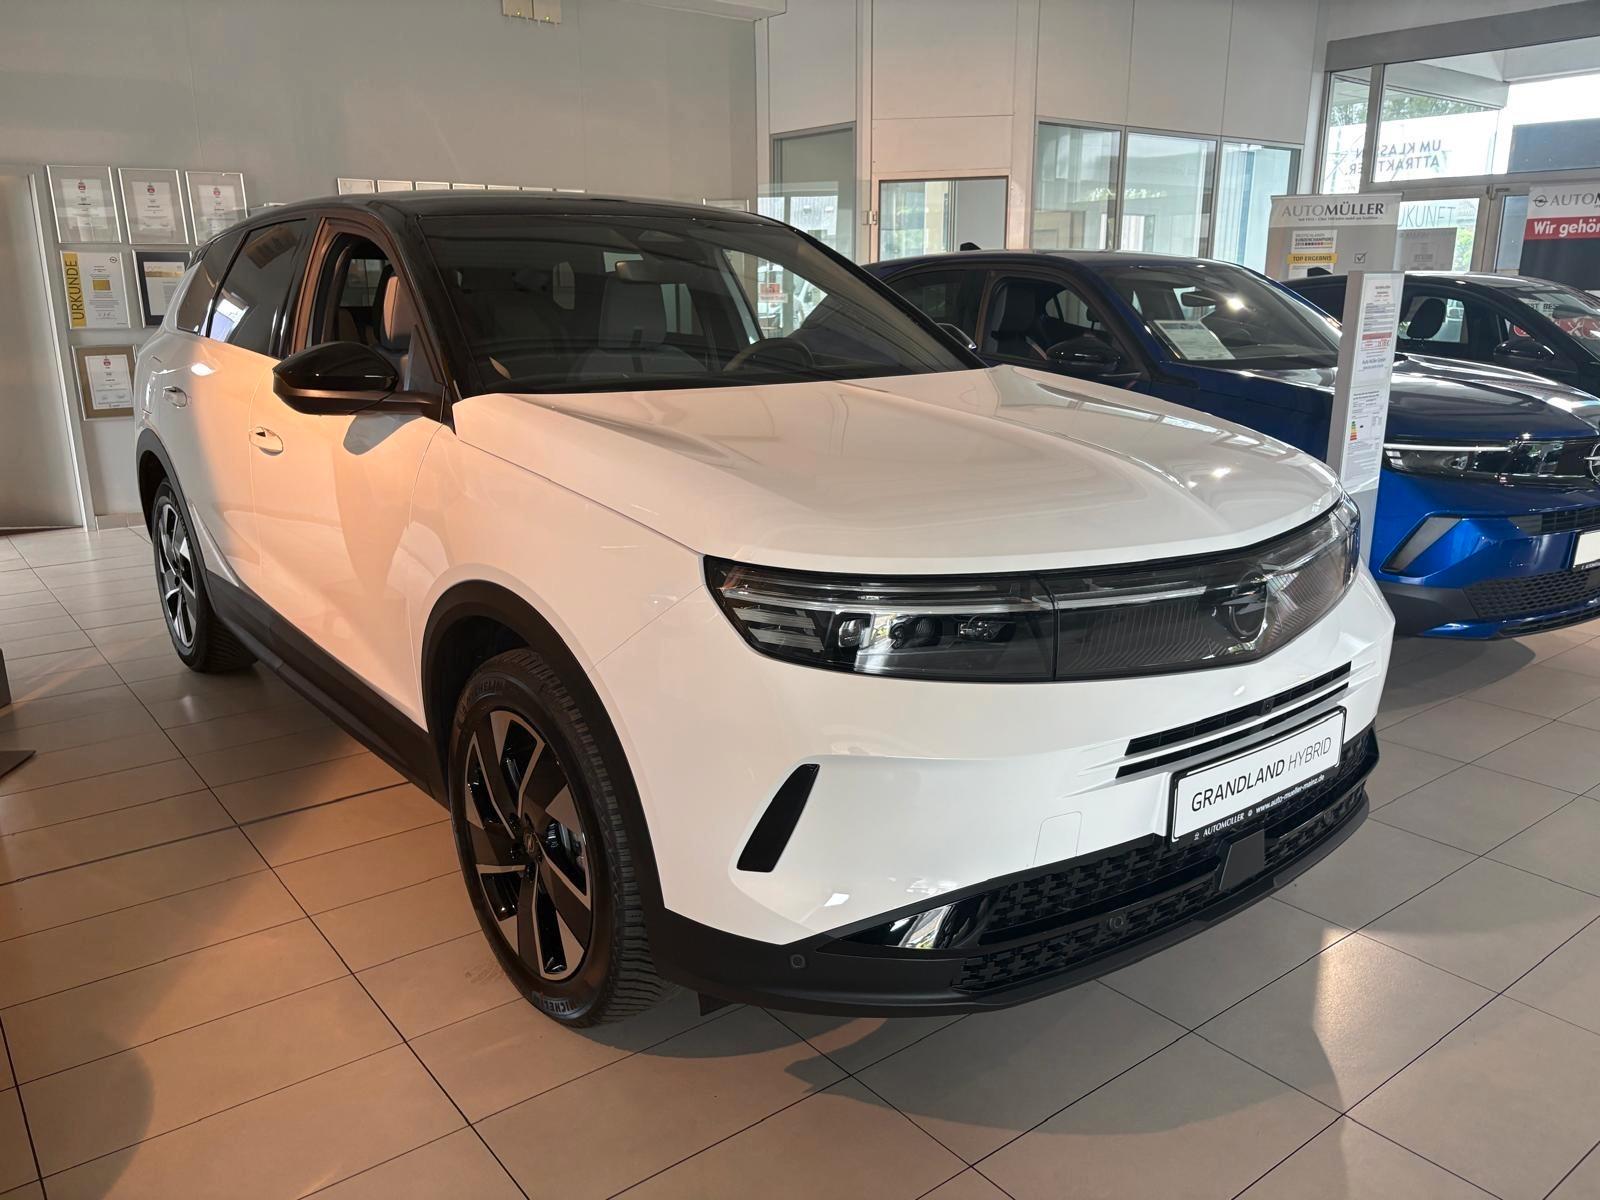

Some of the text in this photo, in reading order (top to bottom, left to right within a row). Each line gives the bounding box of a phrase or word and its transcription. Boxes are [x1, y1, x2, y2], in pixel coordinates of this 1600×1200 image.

[1549, 191, 1600, 206] AUTO
[1282, 201, 1385, 217] AUTOMÜLLER
[1534, 221, 1557, 235] Wir
[1305, 254, 1333, 262] ERGEBNIS
[65, 259, 85, 320] URKUNDE
[1191, 736, 1332, 812] GRANDLAND HYBRID
